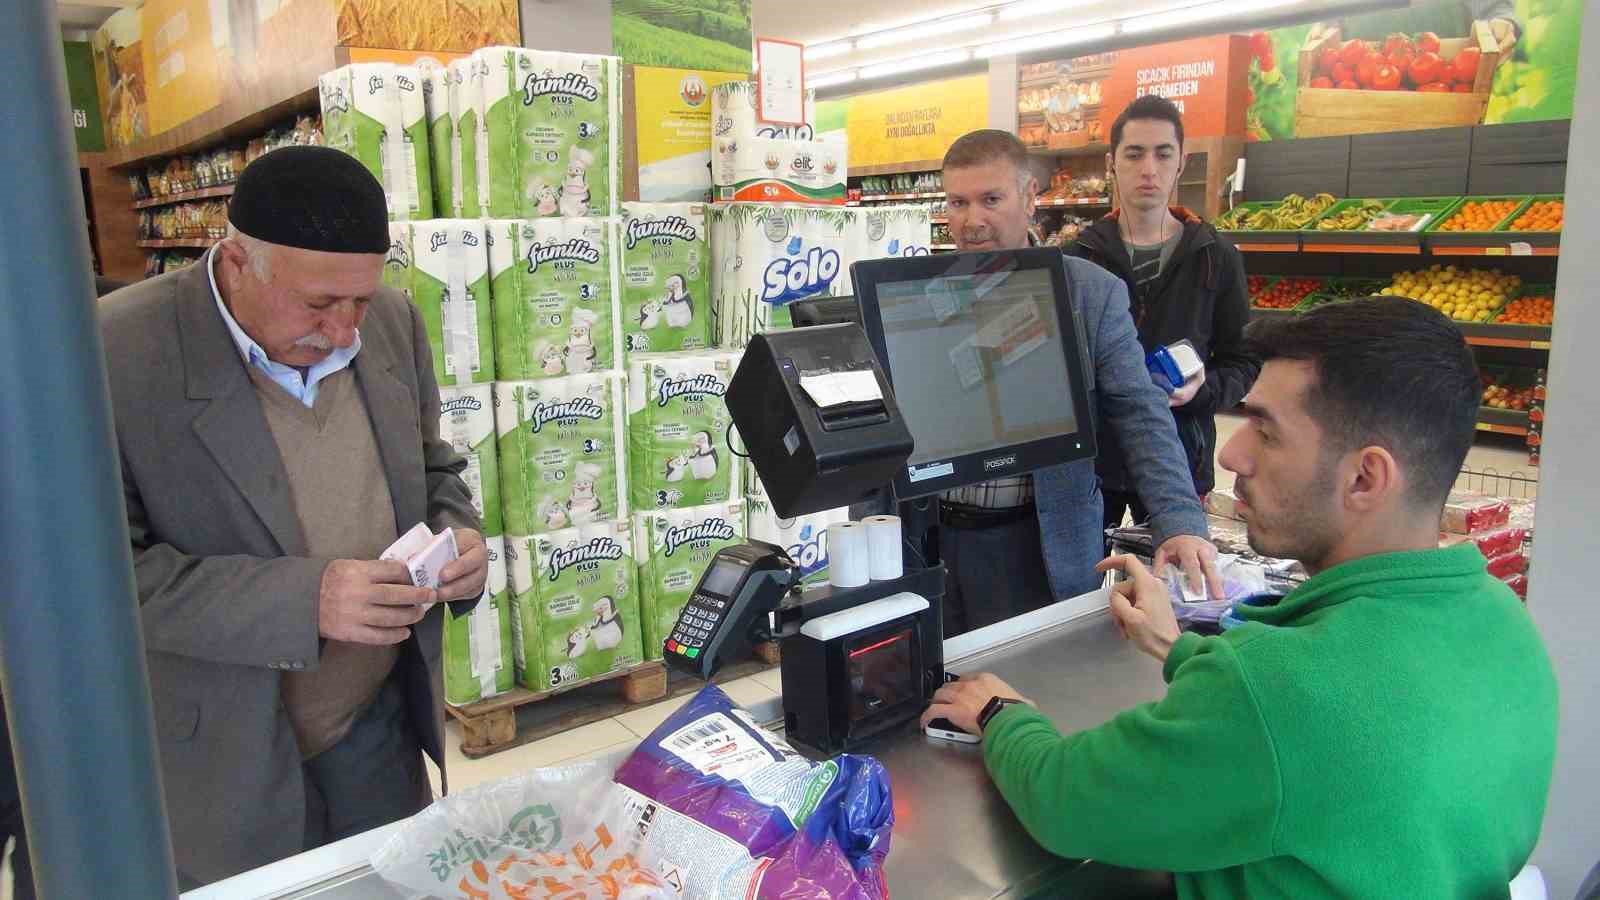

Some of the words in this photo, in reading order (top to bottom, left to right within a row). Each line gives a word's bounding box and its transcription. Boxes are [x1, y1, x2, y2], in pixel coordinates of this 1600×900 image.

[1171, 60, 1215, 81] FIRINDAN
[524, 72, 598, 106] familia
[551, 95, 573, 104] PLUS
[579, 122, 589, 137] 3
[794, 156, 815, 170] elit
[627, 216, 696, 250] familia
[652, 238, 673, 246] PLUS
[528, 239, 599, 274] familia
[554, 261, 576, 269] PLUS
[762, 247, 840, 303] Solo
[580, 284, 589, 299] 3
[658, 374, 727, 407] familia
[684, 393, 704, 402] PLUS
[532, 397, 603, 433] familia
[557, 418, 578, 427] PLUS
[584, 439, 594, 454] 3
[665, 517, 734, 557] familia
[690, 541, 711, 550] PLUS
[549, 537, 624, 582] familia
[576, 561, 600, 573] PLUS
[551, 667, 562, 685] 3
